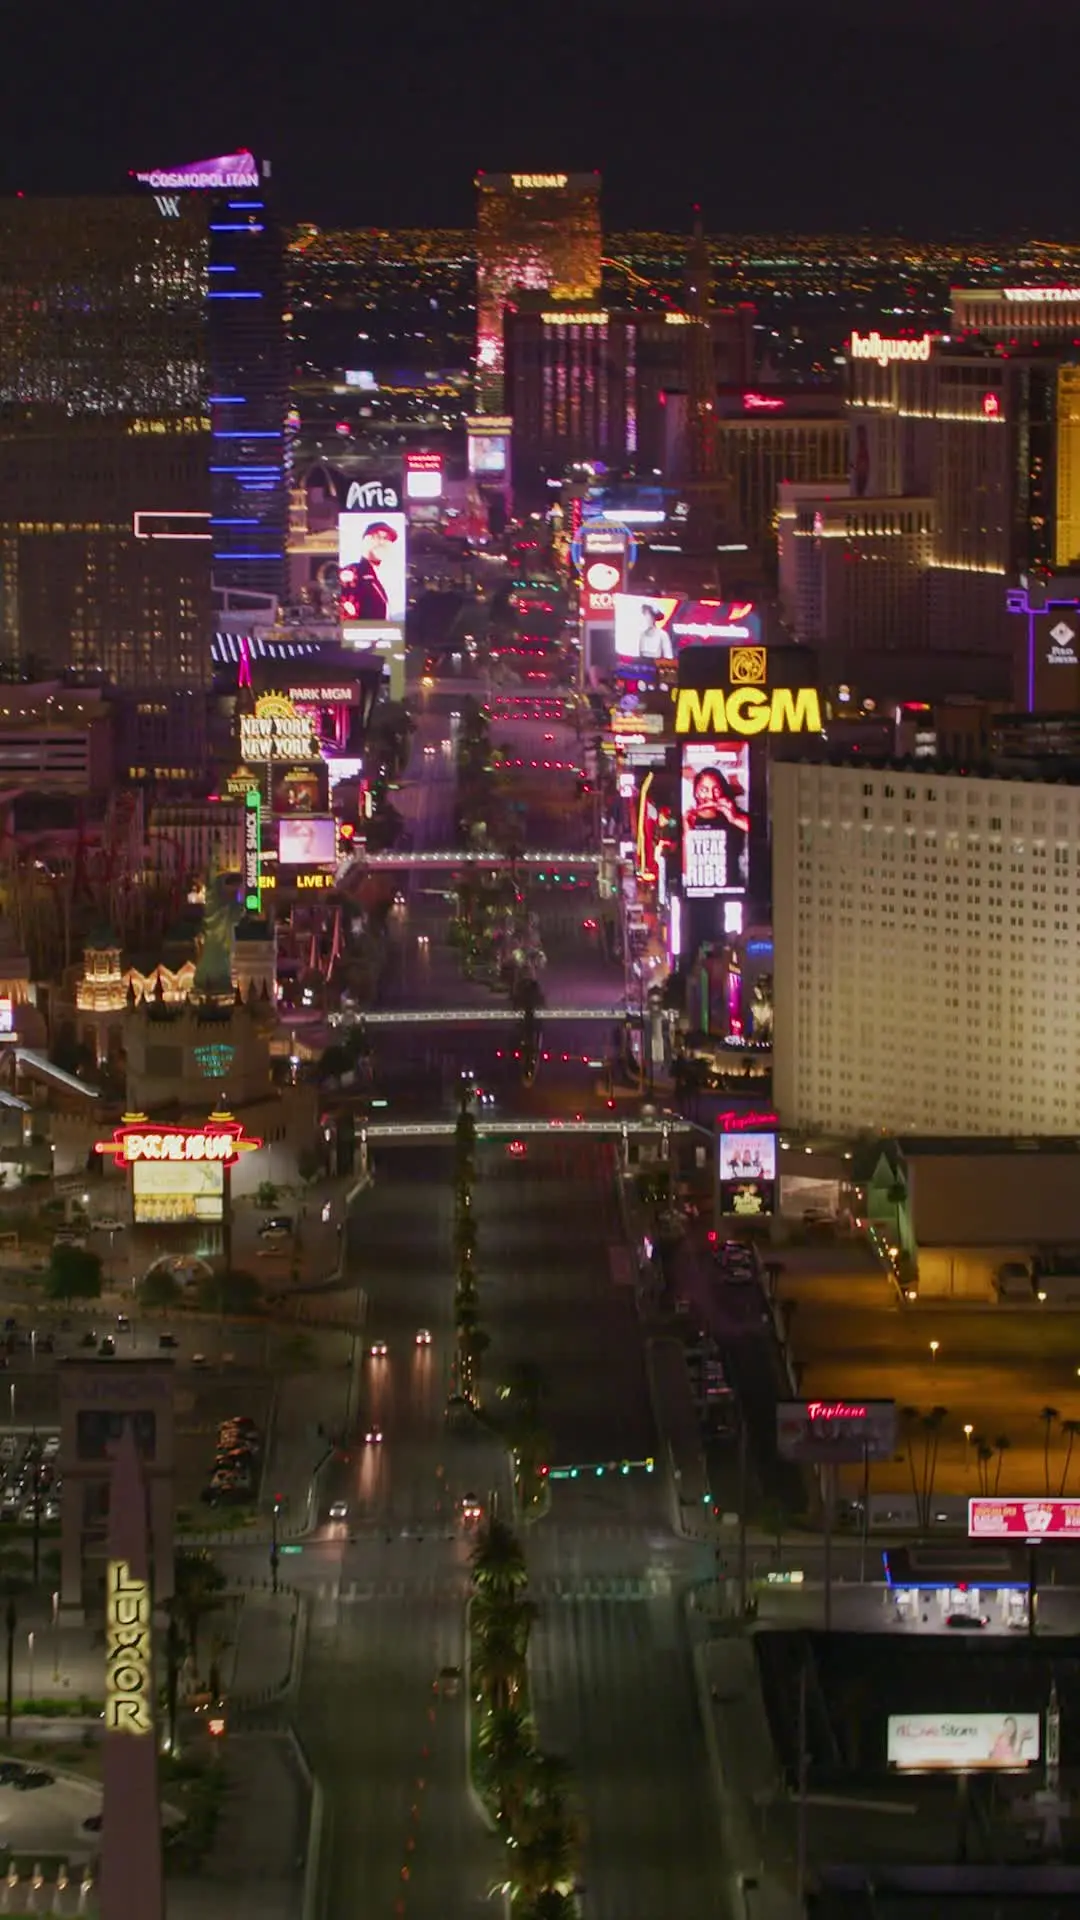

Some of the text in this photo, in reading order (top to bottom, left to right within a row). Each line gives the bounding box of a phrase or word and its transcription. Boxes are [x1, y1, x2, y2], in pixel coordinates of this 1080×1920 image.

[149, 173, 260, 187] COSMOPOLITAN
[511, 174, 568, 188] TRUMP
[540, 313, 609, 324] TREASURE
[851, 331, 931, 367] hollywood
[288, 688, 352, 699] PARK MGM
[674, 687, 822, 735] MGM
[240, 716, 312, 735] NEW YORK
[240, 738, 312, 756] NEW YORK
[246, 813, 257, 888] SHAKE SHACK
[296, 875, 324, 888] LIVE
[126, 1135, 233, 1160] EXCALIBUR
[107, 1561, 152, 1735] LUXOR
